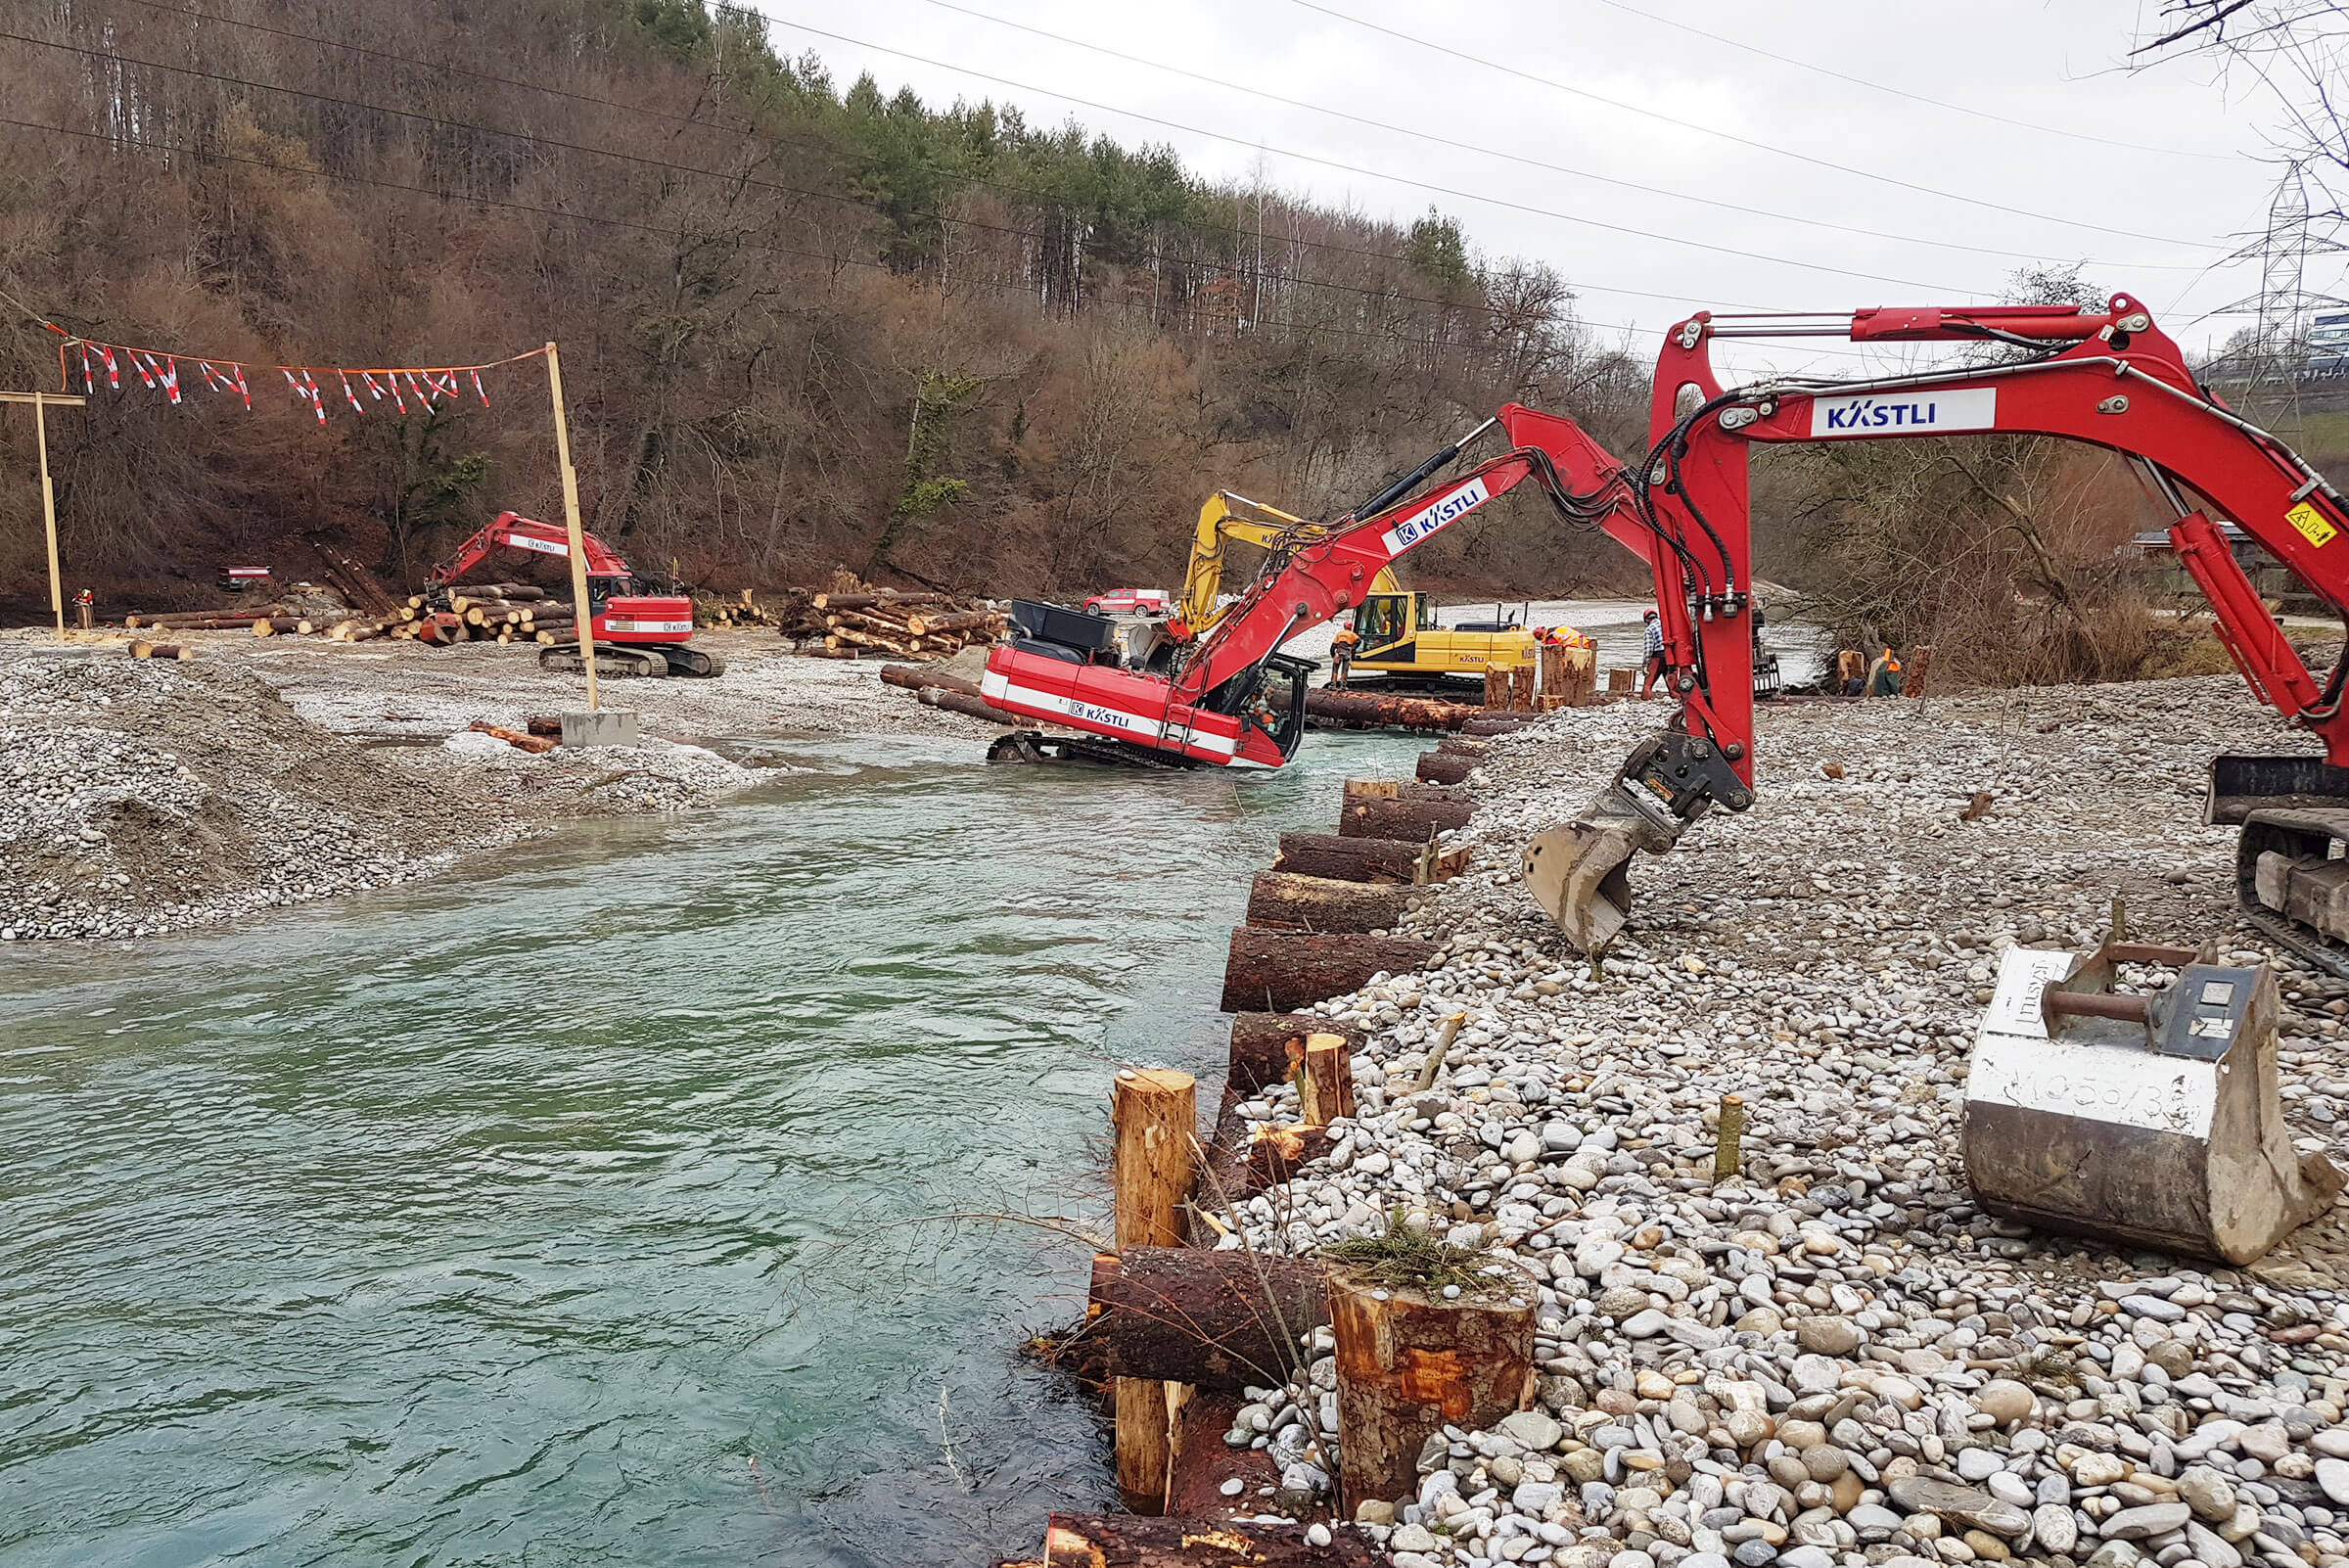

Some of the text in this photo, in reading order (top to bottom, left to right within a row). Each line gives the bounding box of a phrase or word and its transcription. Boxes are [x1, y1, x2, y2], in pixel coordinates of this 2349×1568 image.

[1827, 399, 1936, 429] KÄSTLI
[1419, 489, 1480, 533] KÄSTLI
[1459, 654, 1485, 663] KÄSTLI
[1086, 708, 1129, 728] KÄSTLI
